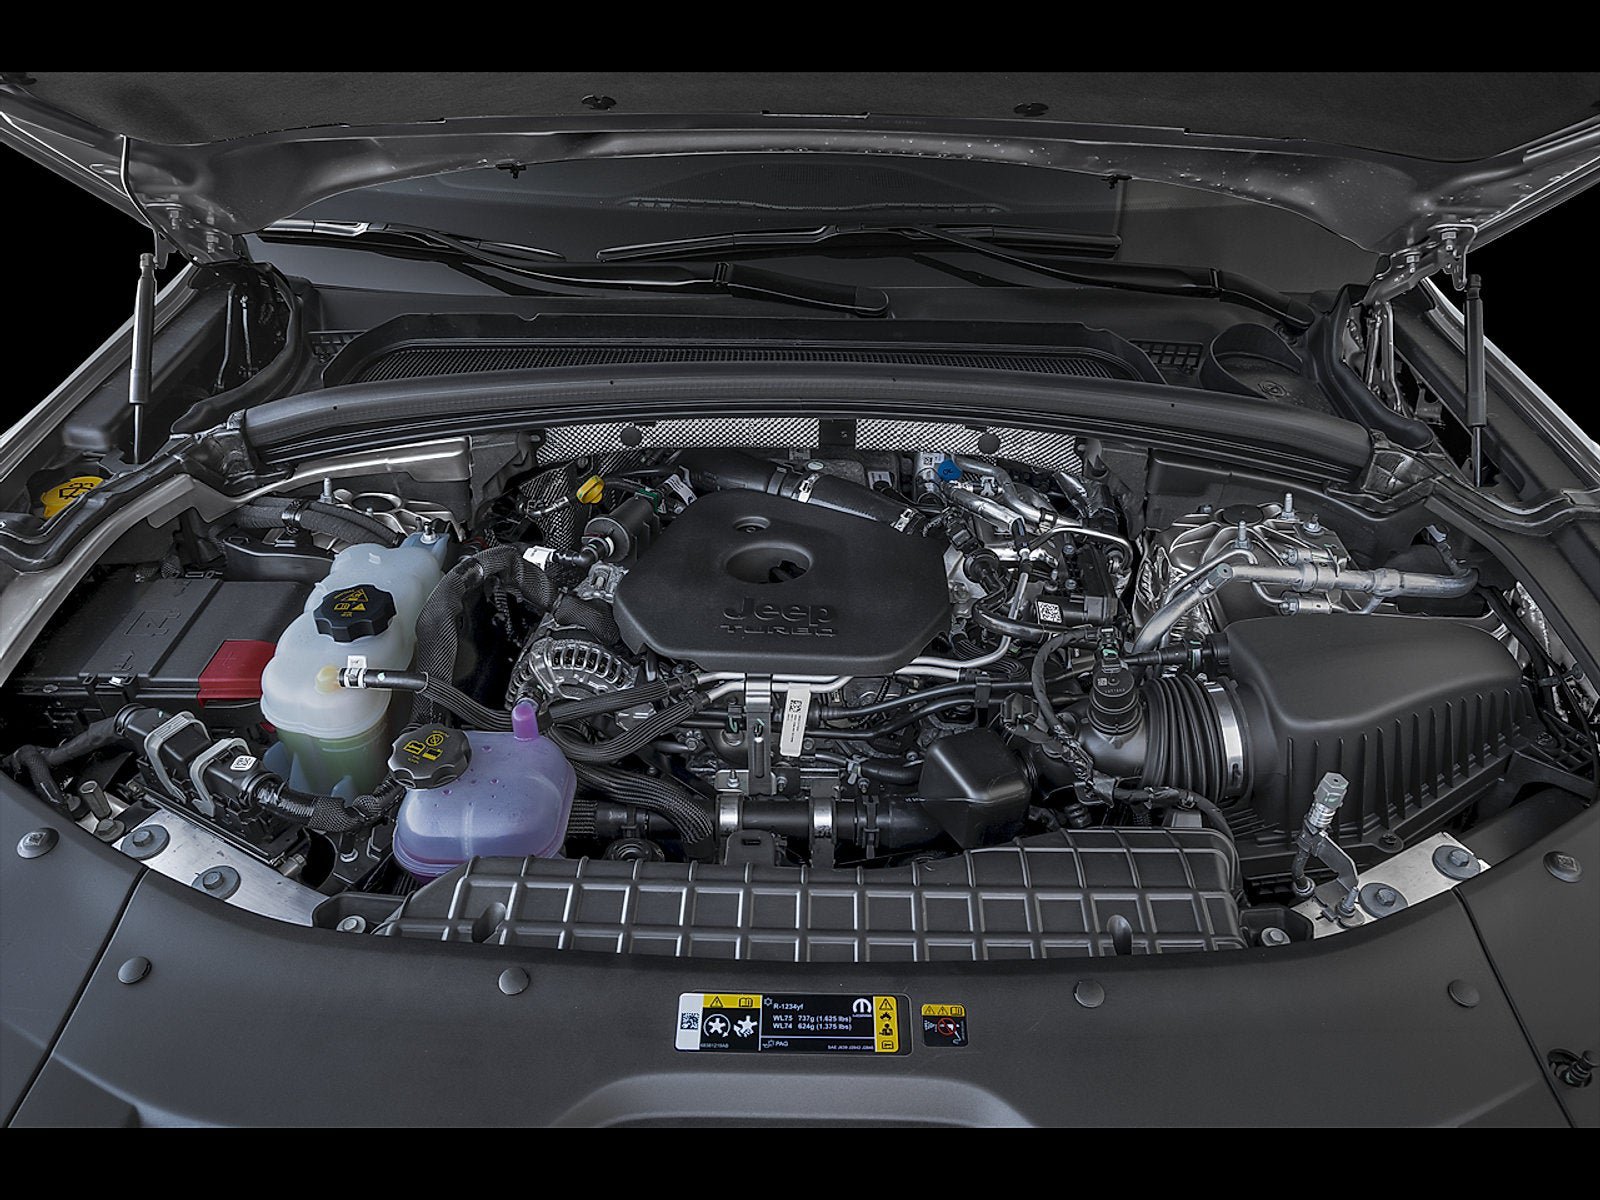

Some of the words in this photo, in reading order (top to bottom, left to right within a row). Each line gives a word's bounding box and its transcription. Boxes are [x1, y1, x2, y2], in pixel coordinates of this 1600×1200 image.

[722, 598, 837, 626] Jeep
[720, 625, 836, 638] TURBO
[773, 1003, 804, 1011] R-1234yf
[798, 1015, 815, 1023] 737g
[838, 1015, 852, 1023] lbs)
[797, 1023, 815, 1031] 624g
[816, 1023, 837, 1031] (1.375
